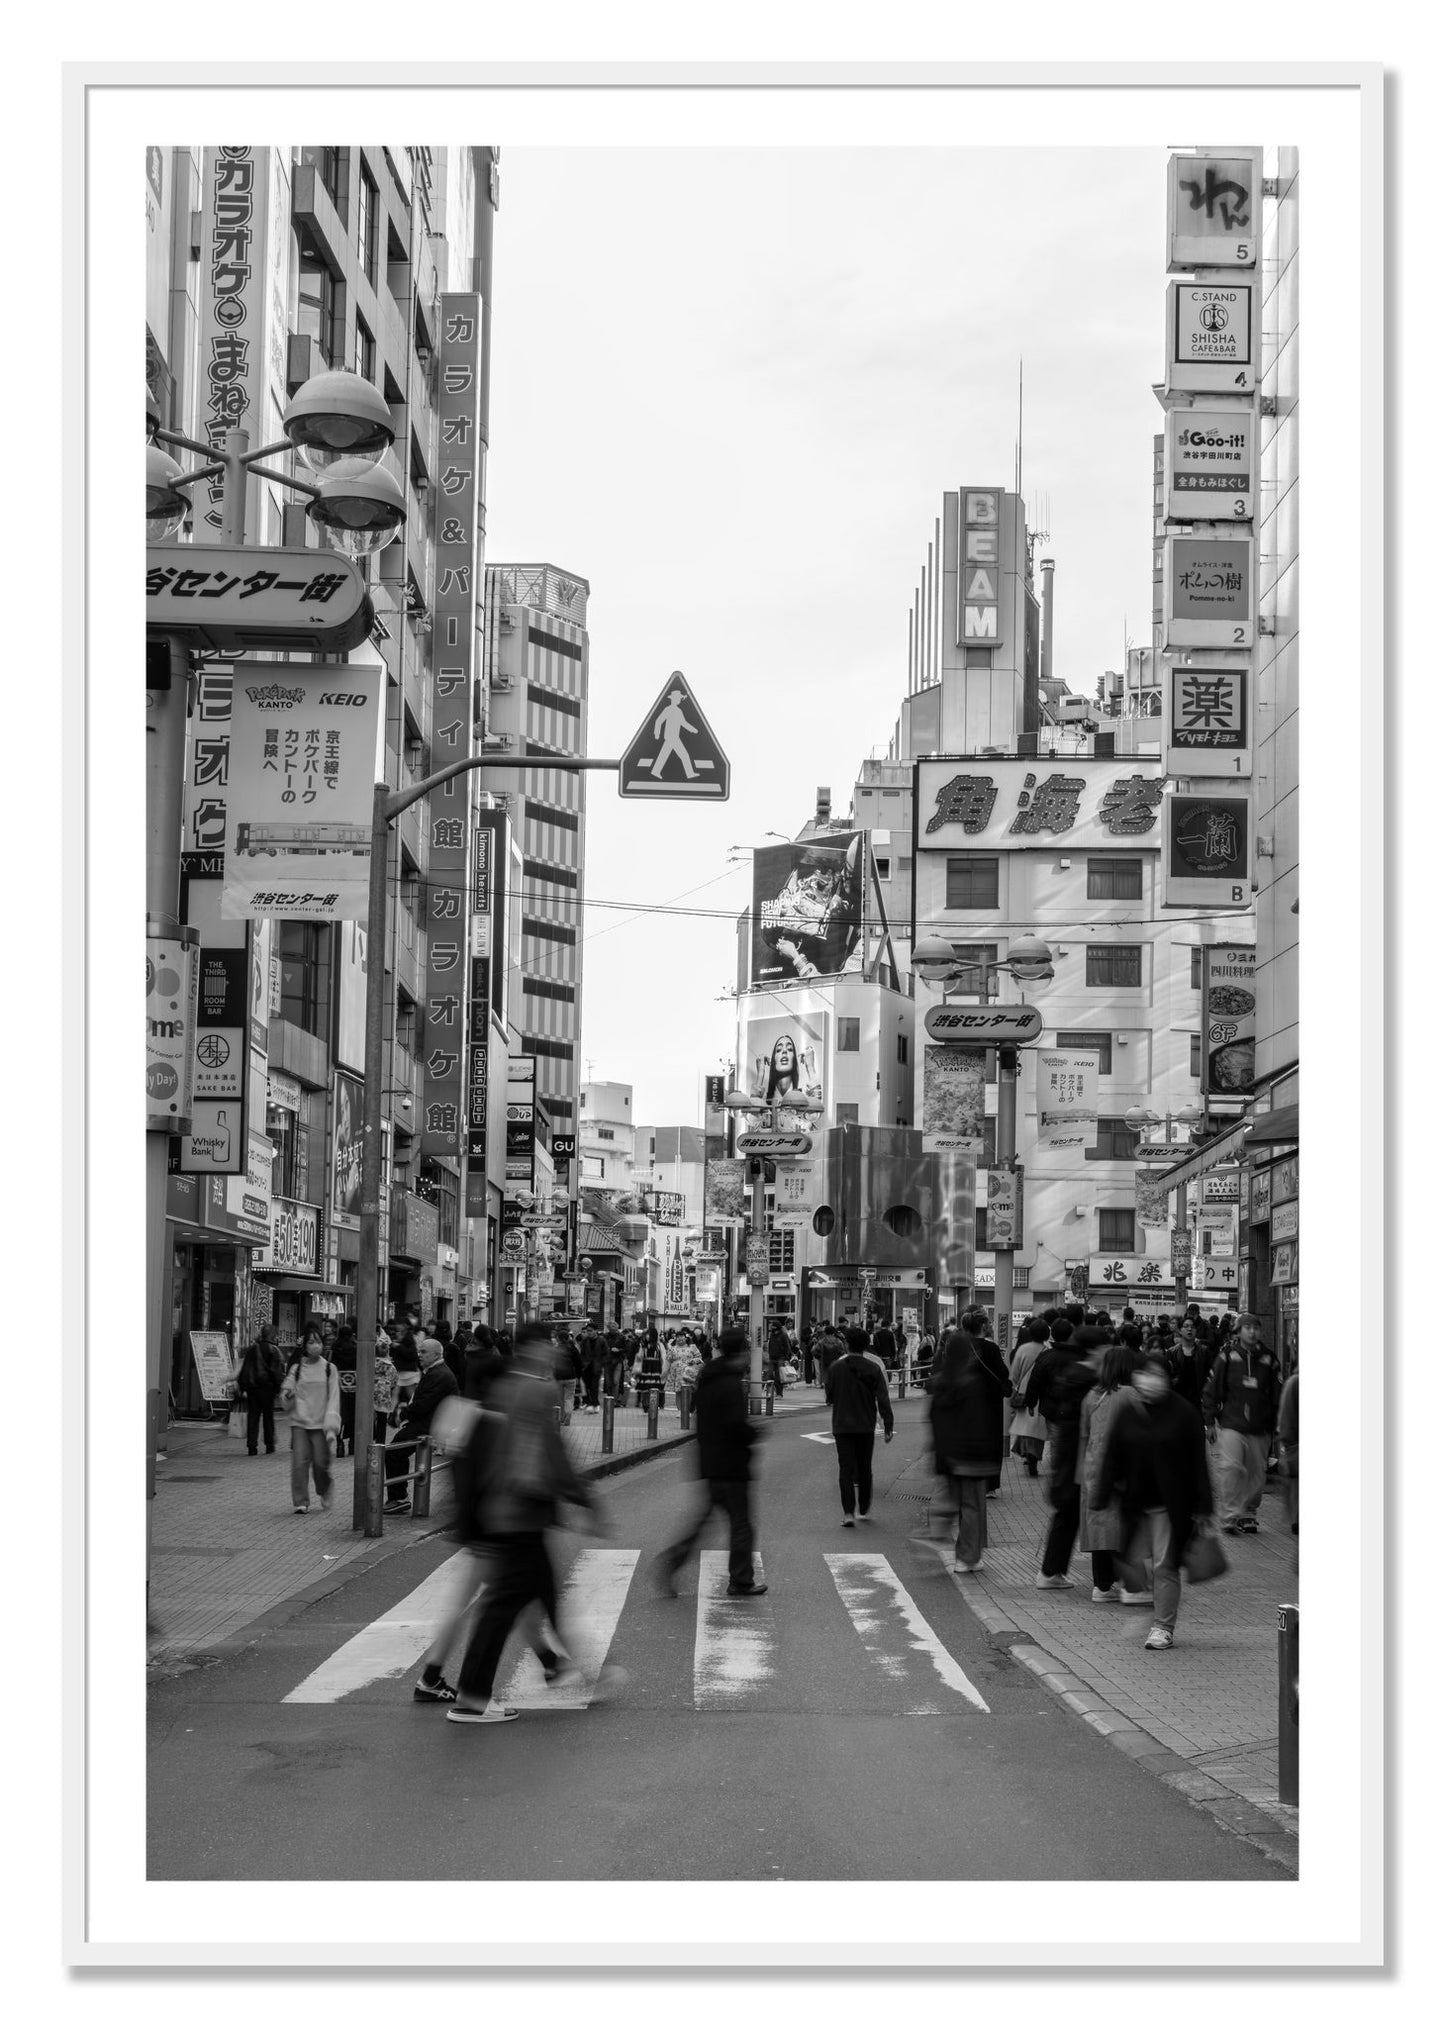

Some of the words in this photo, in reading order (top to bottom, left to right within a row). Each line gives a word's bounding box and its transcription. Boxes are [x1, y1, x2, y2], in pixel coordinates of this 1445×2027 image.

[213, 159, 254, 298] カラオケ
[1236, 244, 1249, 260] 5
[1191, 292, 1237, 302] C.STAND
[1191, 332, 1236, 344] SHISHA
[1191, 344, 1236, 353] CAFE&BAR
[1234, 371, 1247, 387] 4
[1189, 431, 1245, 448] Goo-it!
[1178, 476, 1246, 489] 全身もみほぐし
[1233, 499, 1246, 516] 3
[964, 492, 999, 638] BEAM
[1233, 626, 1246, 643] 2
[258, 701, 303, 709] KANTO
[318, 692, 368, 707] KEIO
[1181, 676, 1234, 728] 薬
[1176, 731, 1239, 745] マツモトキヨシ
[262, 728, 279, 772] 冒険へ
[281, 728, 299, 804] カントーの
[302, 728, 320, 804] ポケパーク
[323, 730, 341, 790] 京王線で
[1232, 756, 1242, 772] 1
[925, 772, 1164, 835] 角海老
[477, 833, 487, 869] kimono
[250, 892, 339, 906] 渋谷センター街
[1231, 885, 1243, 902] B
[204, 968, 228, 976] THIRD
[207, 961, 224, 969] THE
[1211, 965, 1256, 978] 四川料理
[204, 997, 226, 1005] ROOM
[207, 1007, 222, 1015] BAR
[932, 1014, 1036, 1028] 渋谷センター街
[1209, 1023, 1239, 1044] 6F
[191, 1146, 212, 1156] Bank
[192, 1137, 226, 1149] Whisky
[554, 1140, 574, 1152] GU
[672, 1259, 682, 1302] BEER
